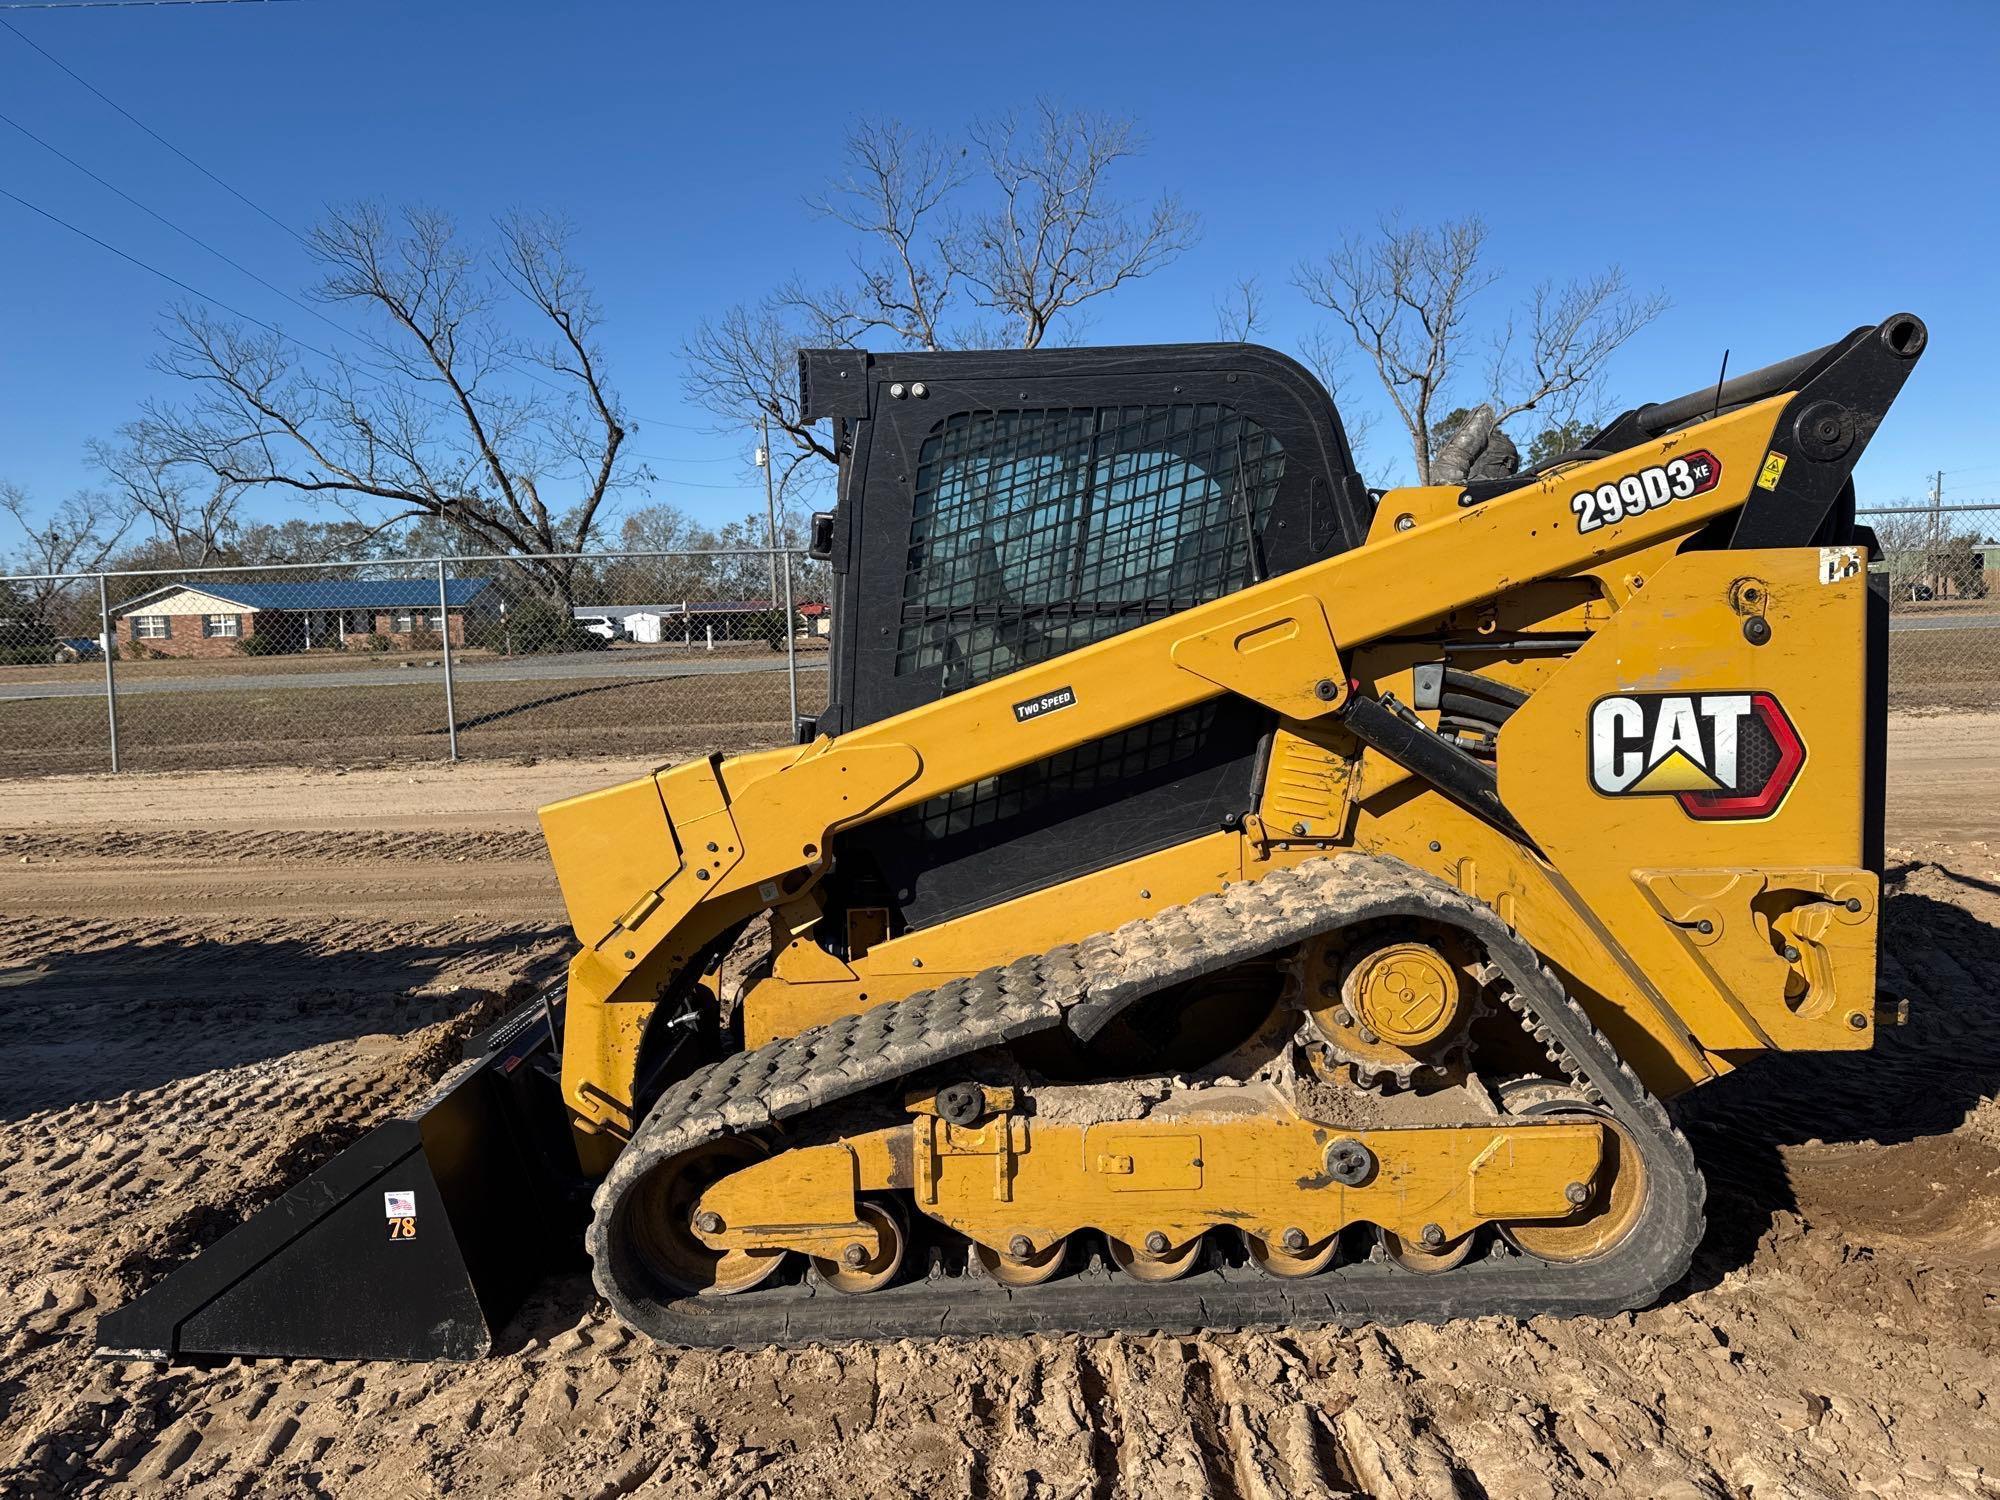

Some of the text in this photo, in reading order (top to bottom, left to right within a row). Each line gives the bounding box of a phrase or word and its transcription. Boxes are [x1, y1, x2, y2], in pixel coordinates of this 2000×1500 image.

[1572, 459, 1710, 533] 299D3 XE
[1593, 695, 1751, 793] CAT
[388, 1217, 416, 1238] 78
